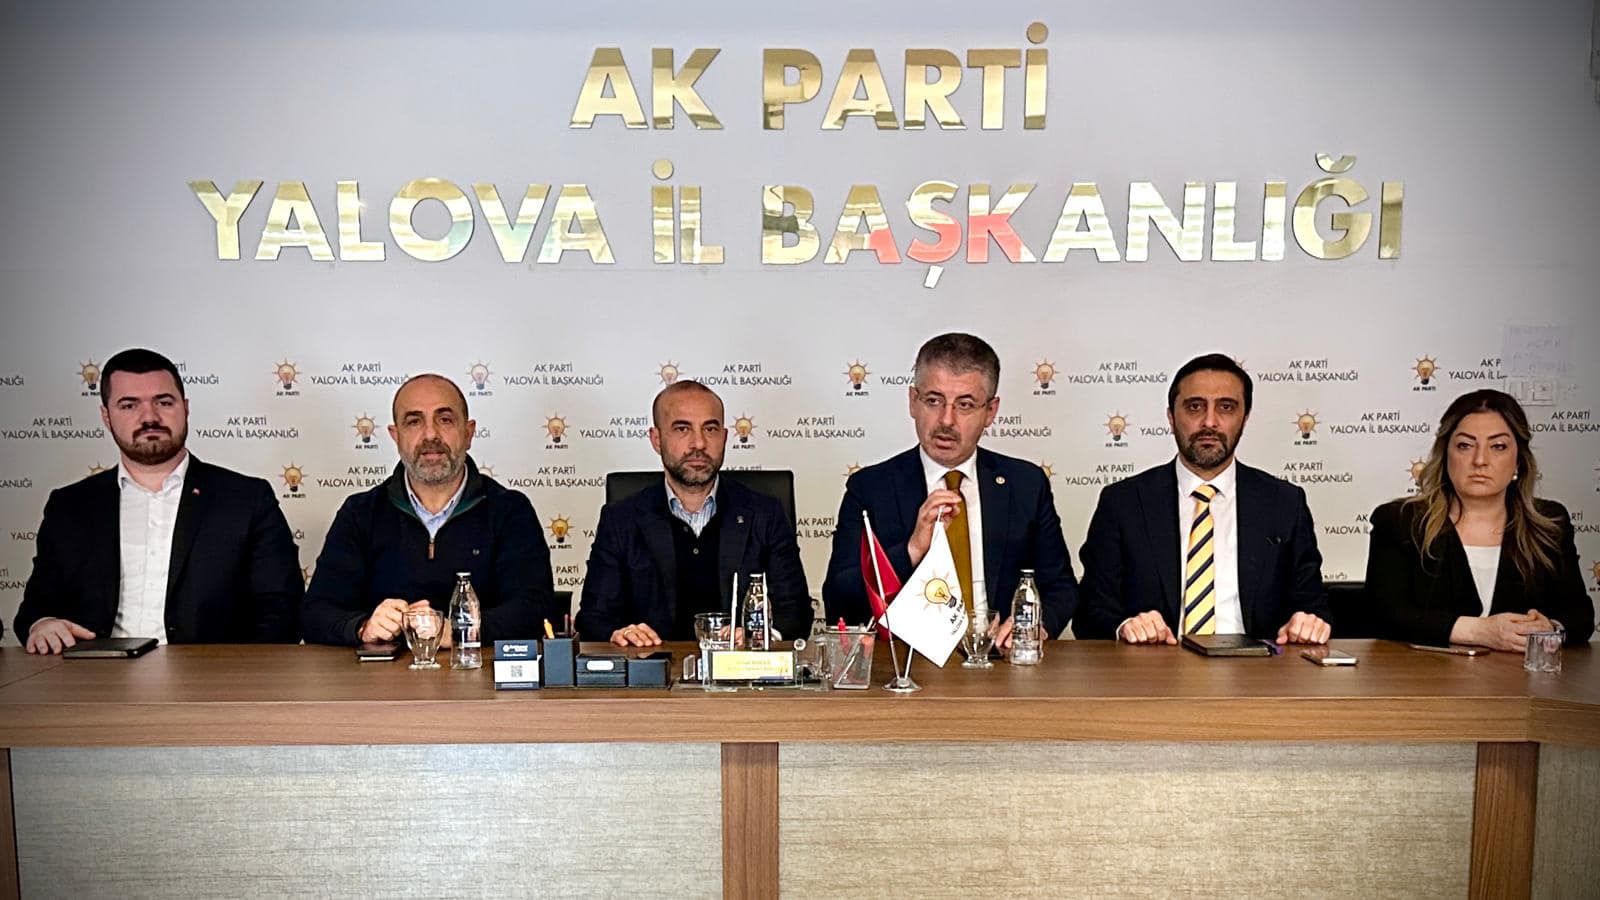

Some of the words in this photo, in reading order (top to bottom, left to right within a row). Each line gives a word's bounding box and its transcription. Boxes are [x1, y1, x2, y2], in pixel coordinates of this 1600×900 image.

[569, 48, 724, 130] AK
[762, 21, 1049, 130] PARTİ
[186, 177, 616, 265] YALOVA
[651, 158, 725, 264] İL
[761, 153, 1404, 289] BAŞKANLIĞI
[1099, 363, 1113, 371] AK
[1289, 361, 1301, 369] AK
[1480, 359, 1494, 367] AK
[341, 364, 354, 372] AK
[534, 364, 548, 373] AK
[723, 364, 736, 373] AK
[183, 374, 219, 385] KANLIĞI
[1068, 375, 1104, 384] YALOVA
[1115, 373, 1168, 385] BAŞKANLIĞI
[1257, 373, 1294, 382] YALOVA
[1305, 370, 1358, 383] BAŞKANLIĞI
[1449, 371, 1486, 380] YALOVA
[311, 376, 349, 385] YALOVA
[503, 376, 540, 385] YALOVA
[552, 374, 604, 387] BAŞKANLIĞI
[740, 375, 792, 387] BAŞKANLIĞI
[1361, 413, 1374, 421] AK
[1551, 411, 1565, 420] AK
[33, 418, 46, 427] AK
[227, 417, 241, 426] AK
[610, 417, 623, 426] AK
[797, 417, 809, 426] AK
[196, 429, 234, 438] YALOVA
[245, 427, 299, 440] BAŞKANLIĞI
[1000, 427, 1052, 438] BAŞKANLIĞI
[1140, 427, 1173, 436] YALOV
[1329, 425, 1366, 434] YALOVA
[1377, 423, 1430, 435] BAŞKANLIĞI
[2, 430, 40, 439] YALOVA
[51, 428, 104, 440] BAŞKANLIĞI
[579, 430, 615, 438] YALOVA
[766, 430, 802, 438] YALOVA
[814, 428, 865, 440] BAŞKANLIĞI
[347, 466, 361, 475] AK
[537, 467, 550, 475] AK
[1096, 465, 1109, 473] AK
[1284, 463, 1297, 471] AK
[1066, 477, 1101, 485] YALOVA
[1300, 472, 1353, 483] BAŞKANLIĞI
[317, 479, 354, 488] YALOVA
[508, 479, 544, 488] YALOVA
[797, 517, 810, 526] AK
[1356, 514, 1368, 522] AK
[1324, 526, 1361, 535] YALOVA
[11, 531, 35, 540] YALO
